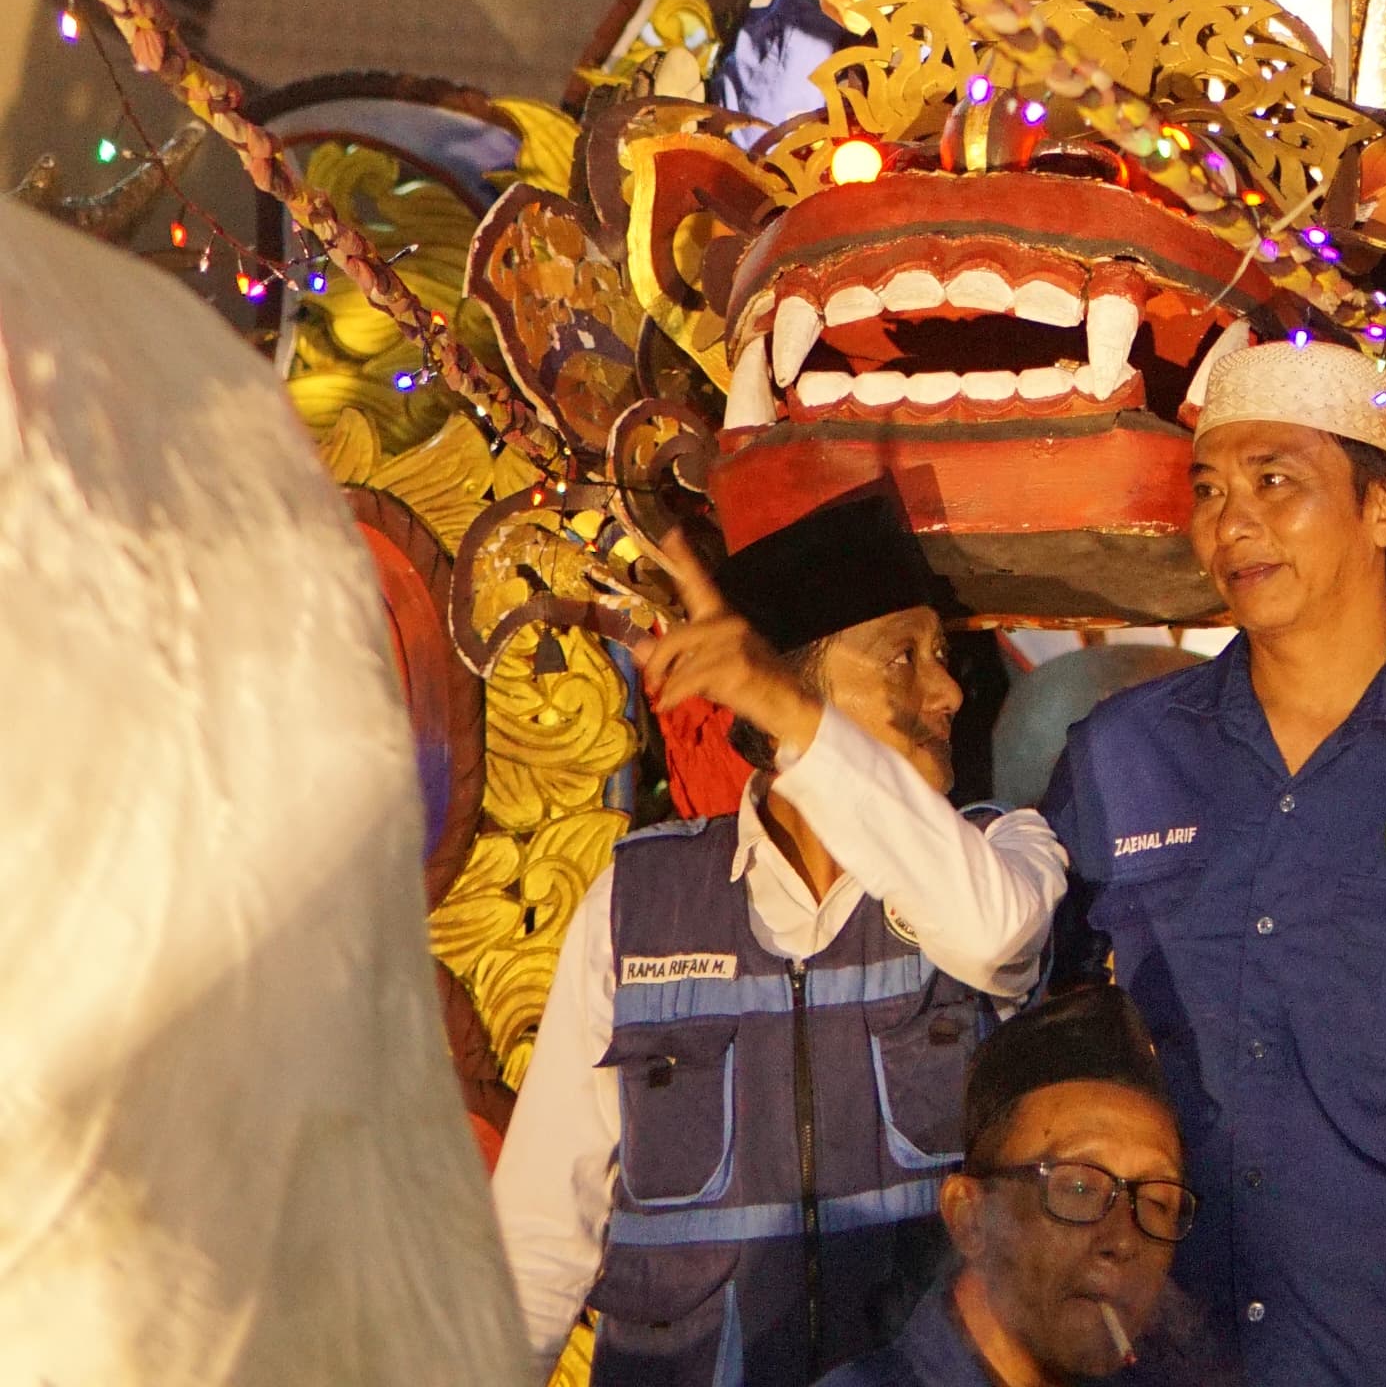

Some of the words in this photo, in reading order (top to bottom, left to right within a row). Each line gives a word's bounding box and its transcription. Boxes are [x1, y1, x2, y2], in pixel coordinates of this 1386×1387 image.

[1114, 832, 1163, 857] ZAENAL
[1165, 827, 1197, 845] ARIF
[627, 962, 665, 979] RAMA
[668, 959, 710, 976] RIFAN
[711, 959, 727, 975] M.
